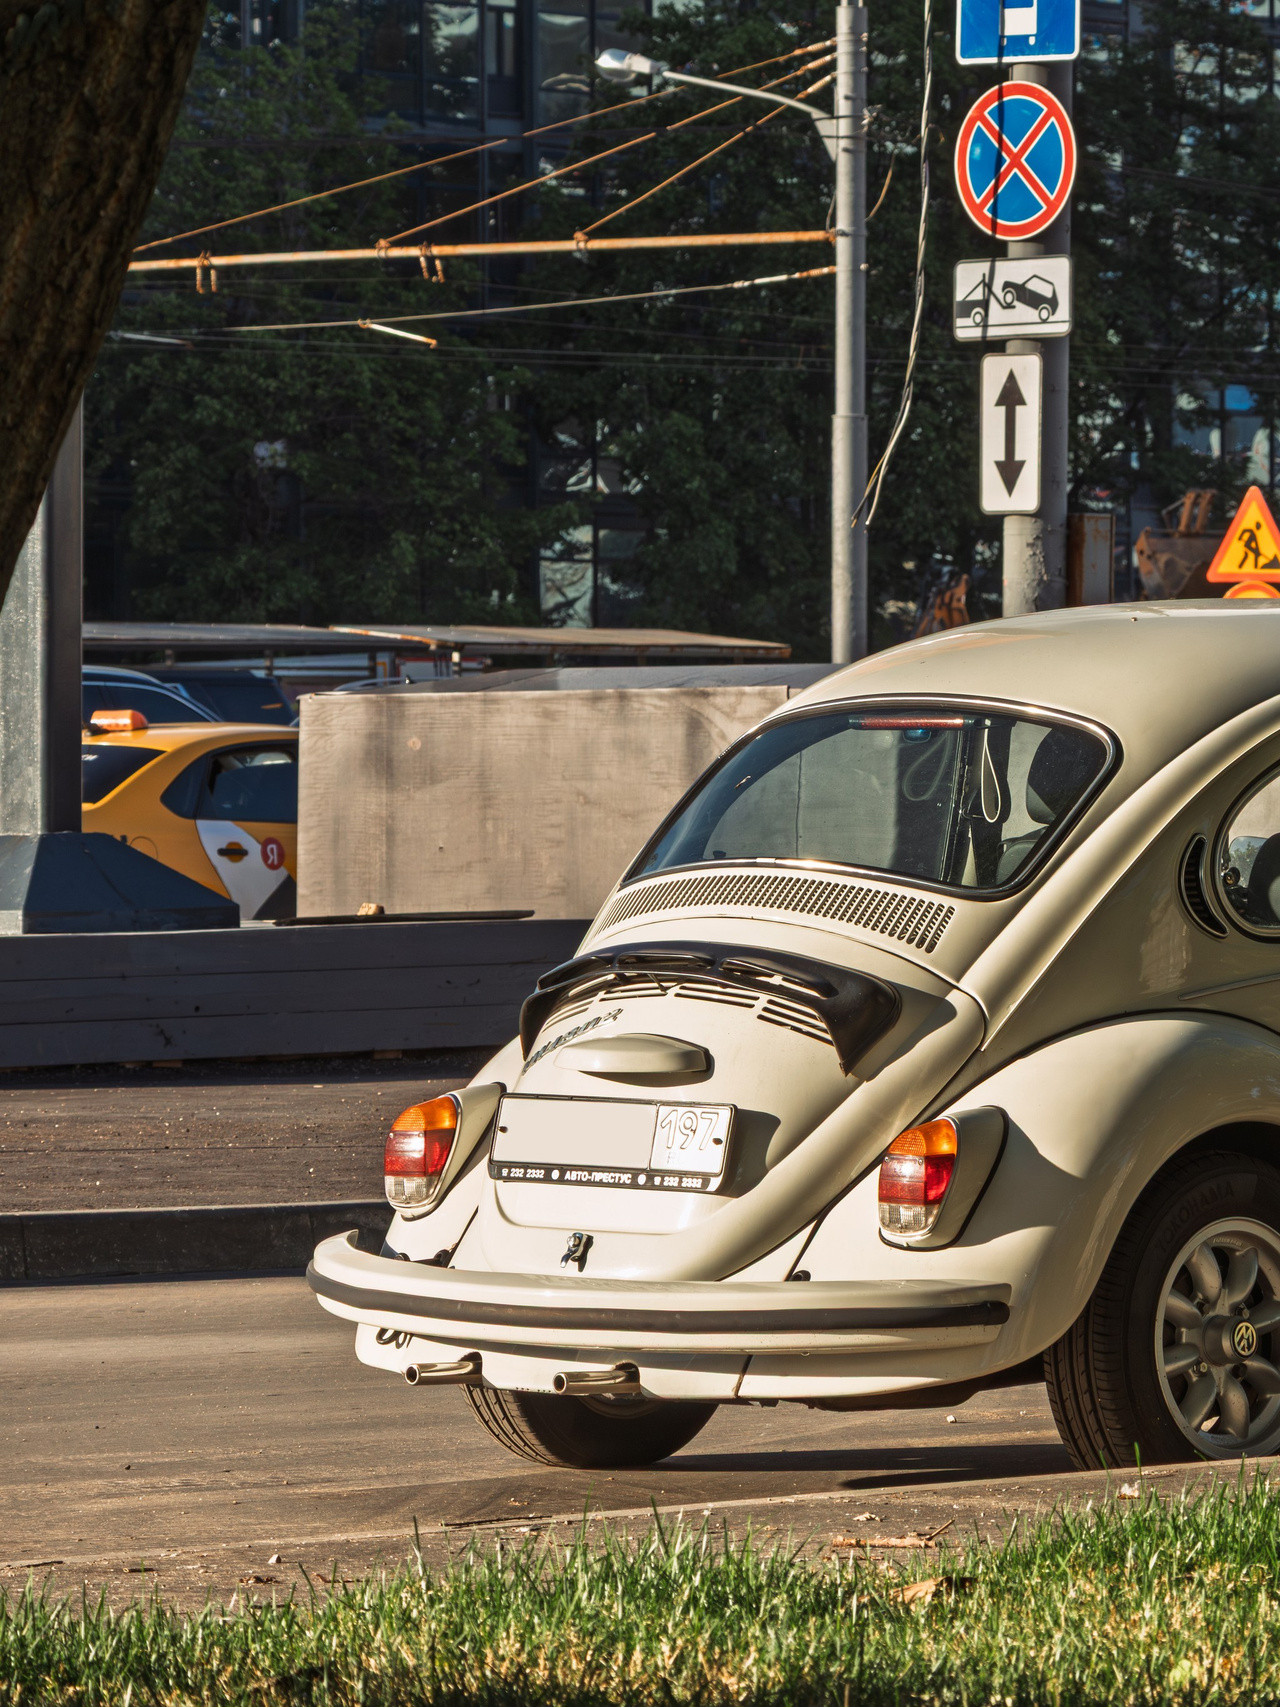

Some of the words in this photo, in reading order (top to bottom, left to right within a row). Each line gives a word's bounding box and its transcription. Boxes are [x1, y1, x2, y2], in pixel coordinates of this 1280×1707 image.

[660, 1109, 720, 1150] 197
[510, 1168, 524, 1178] 232
[564, 1170, 633, 1184] АВТО-ПРЕСТУС
